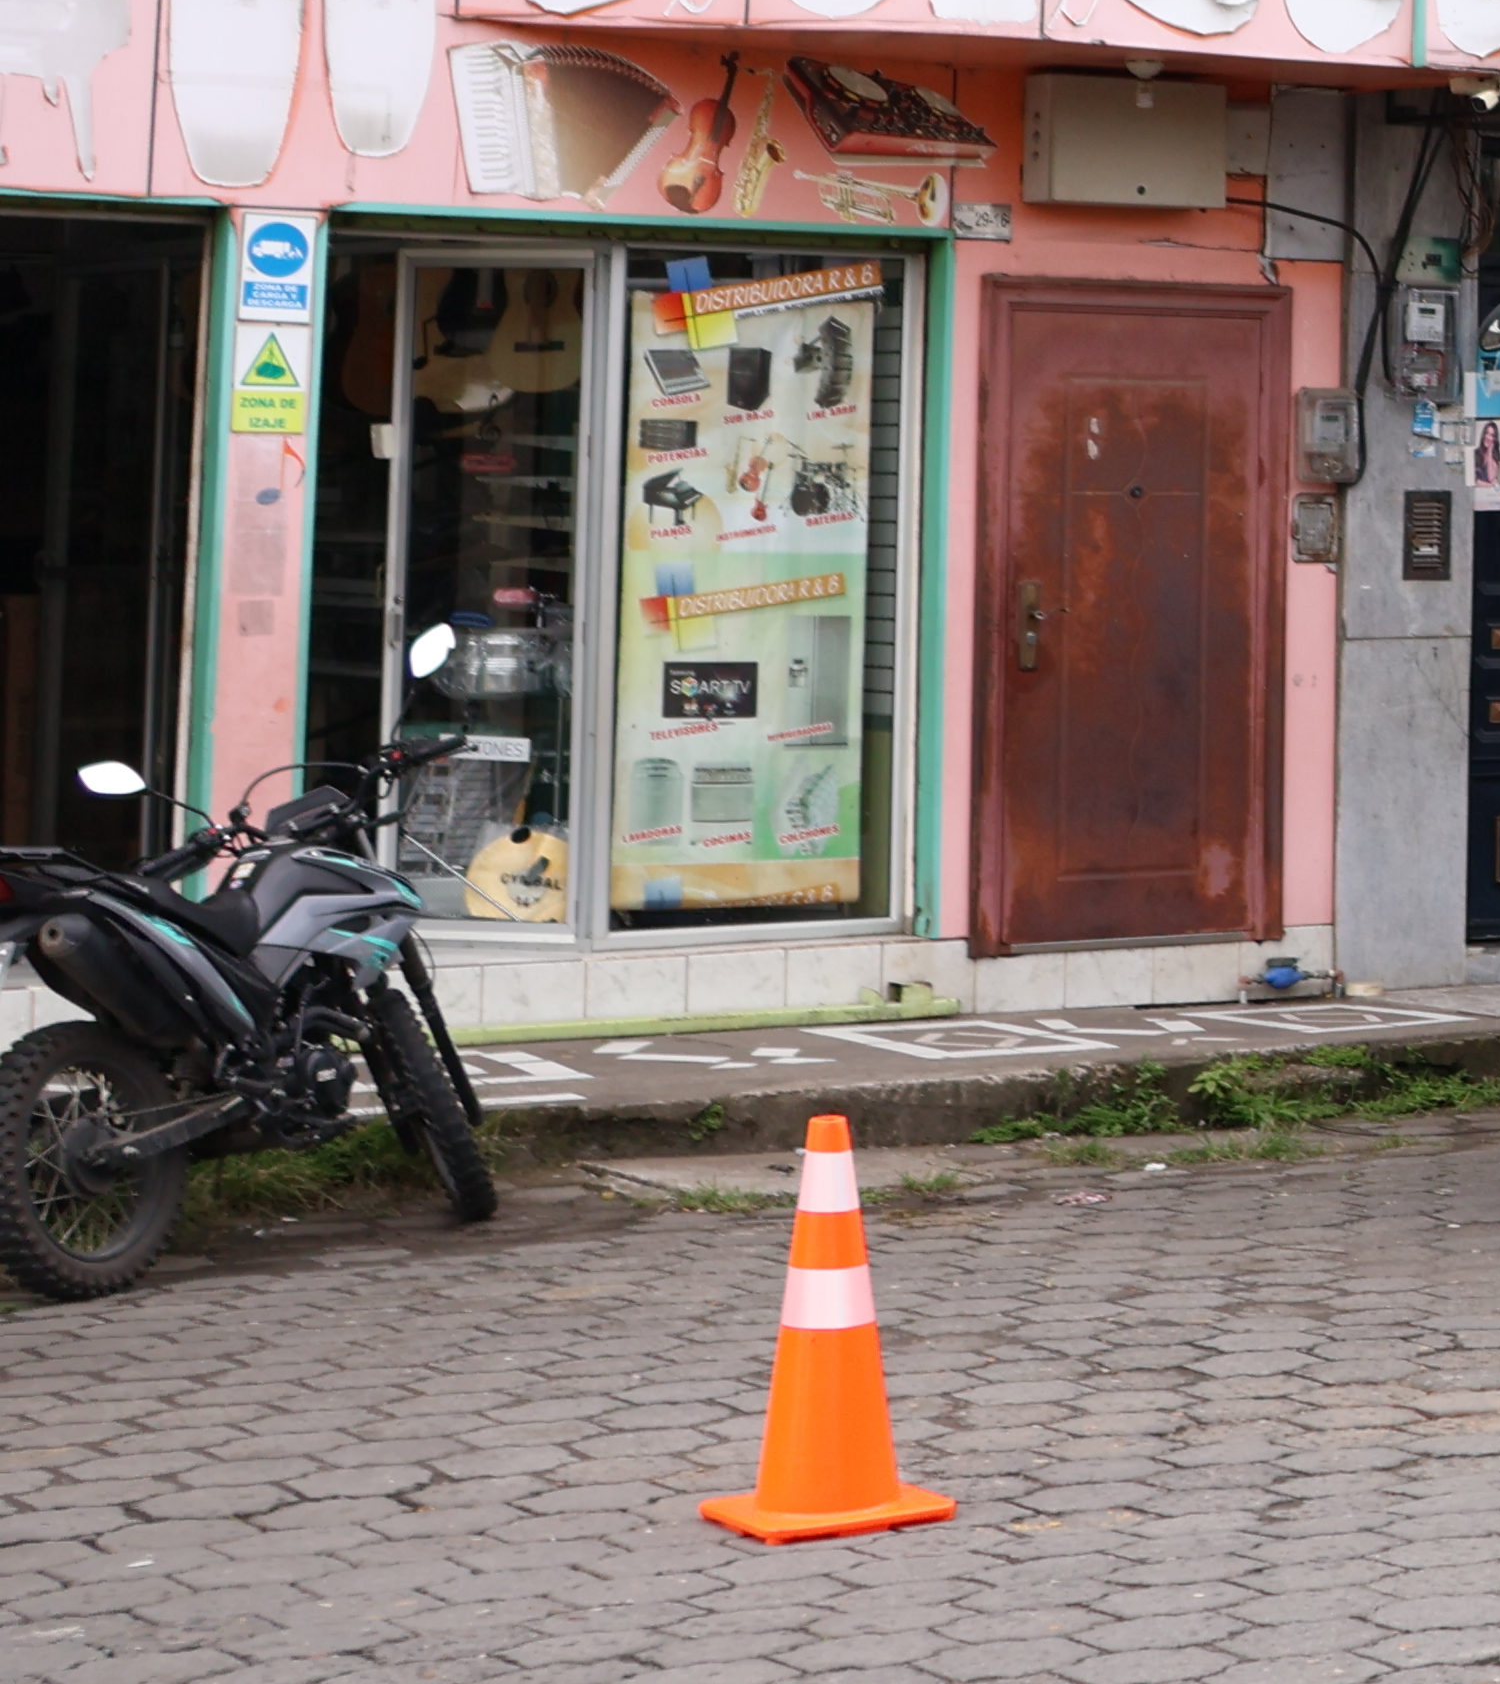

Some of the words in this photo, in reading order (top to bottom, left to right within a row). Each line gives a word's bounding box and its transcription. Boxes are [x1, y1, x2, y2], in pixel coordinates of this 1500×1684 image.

[252, 283, 282, 293] ZONA
[695, 268, 825, 314] DISTRIBUIDORA
[828, 268, 840, 287] R
[845, 268, 857, 283] &
[240, 397, 275, 408] ZONA
[281, 398, 297, 410] DE
[651, 393, 702, 408] CONSOLA
[723, 412, 744, 425] SUB
[746, 410, 775, 422] BAJO
[806, 408, 827, 421] LINE
[249, 417, 287, 430] IZAJE
[647, 448, 708, 464] POTENCIAS
[650, 524, 692, 539] PIANOS
[679, 582, 797, 617] DISTRIBUIDORA
[622, 825, 683, 844] LAVADORAS
[702, 830, 752, 848] COCINAS
[778, 824, 841, 845] COLCHONES
